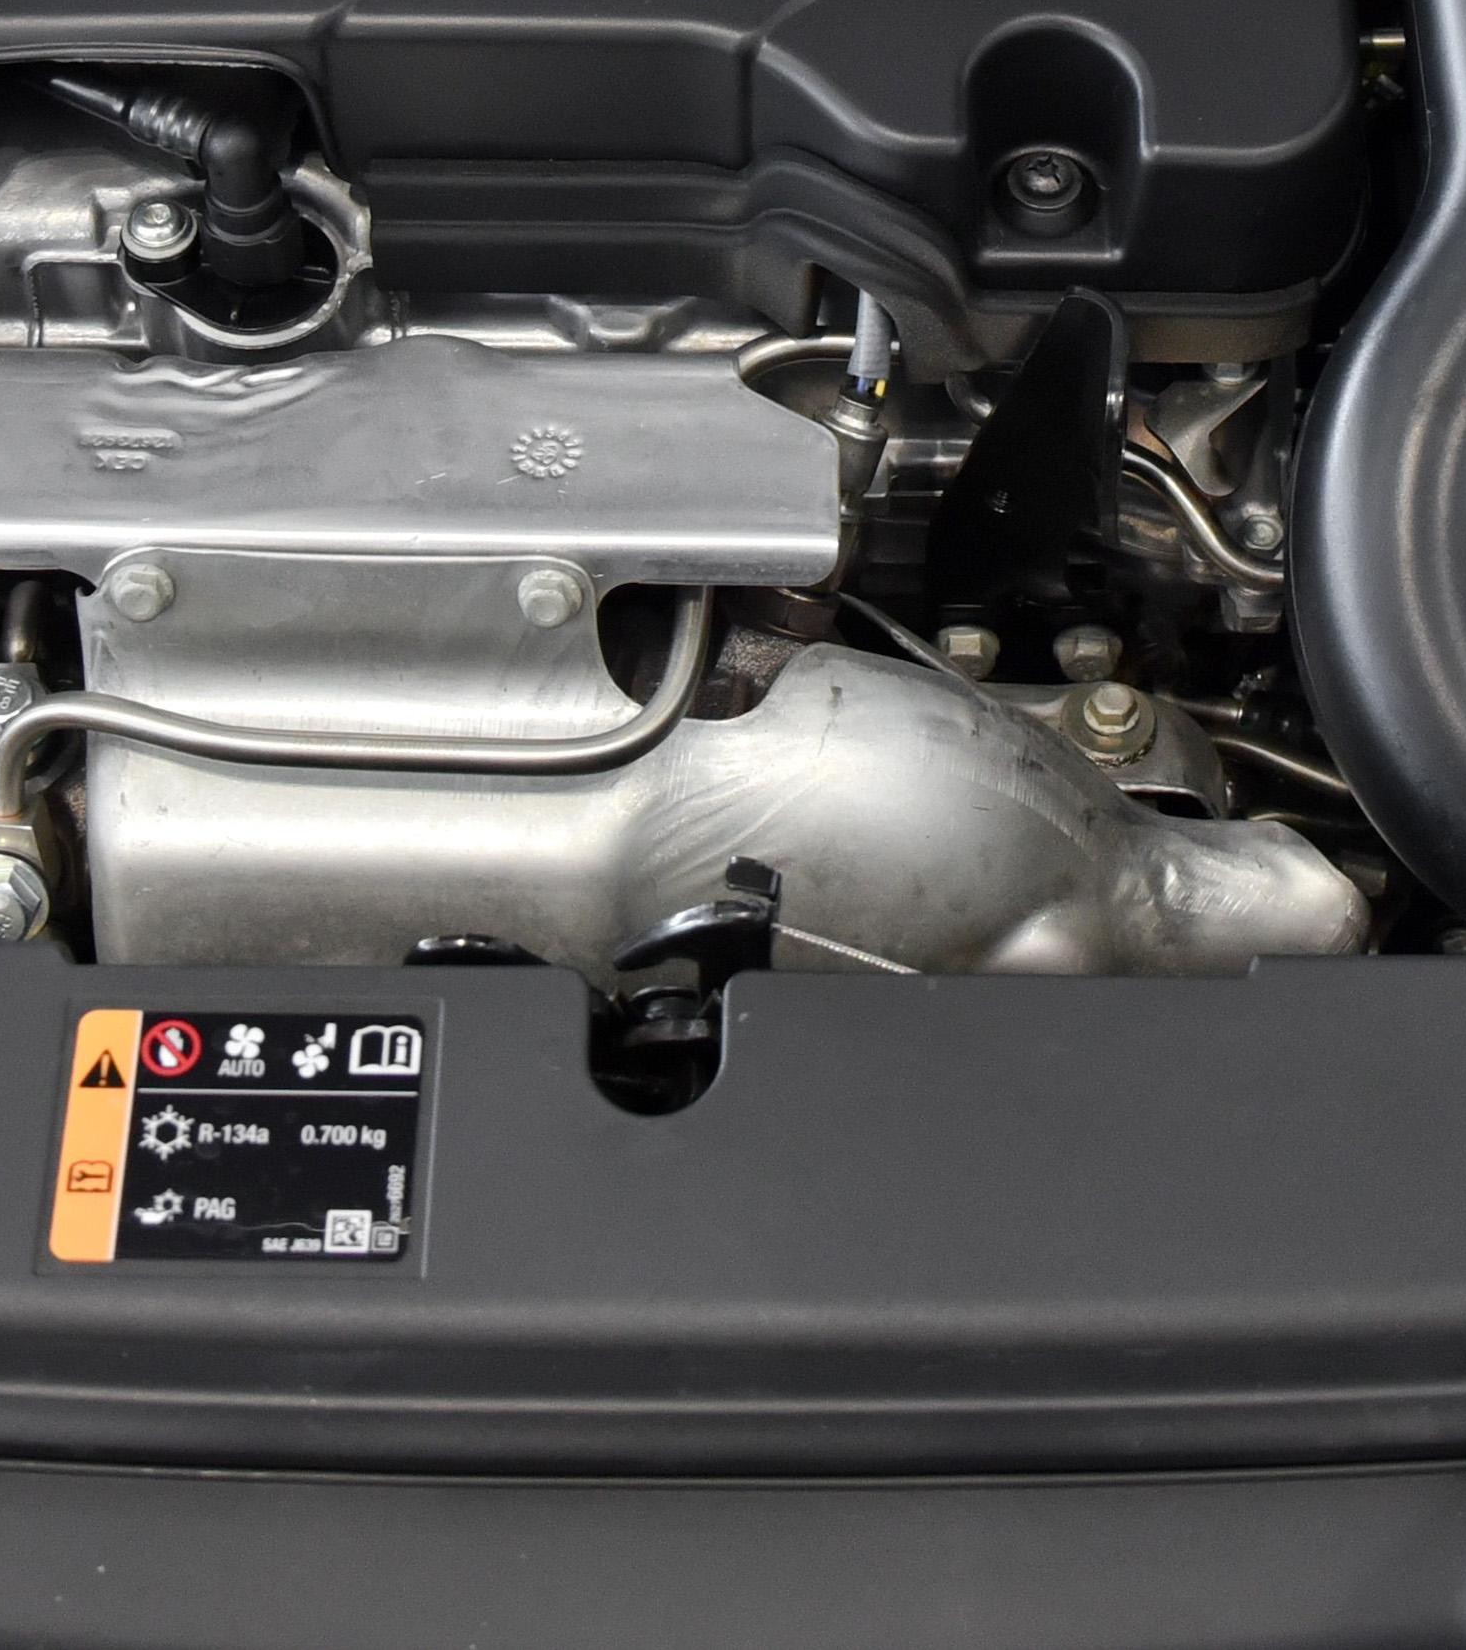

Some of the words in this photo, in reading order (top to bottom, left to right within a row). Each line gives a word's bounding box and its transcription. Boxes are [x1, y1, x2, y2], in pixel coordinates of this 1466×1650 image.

[217, 1059, 266, 1078] AUTO
[197, 1124, 270, 1145] R-134a
[301, 1124, 358, 1146] 0.700
[361, 1125, 387, 1150] kg
[193, 1197, 237, 1220] PAG
